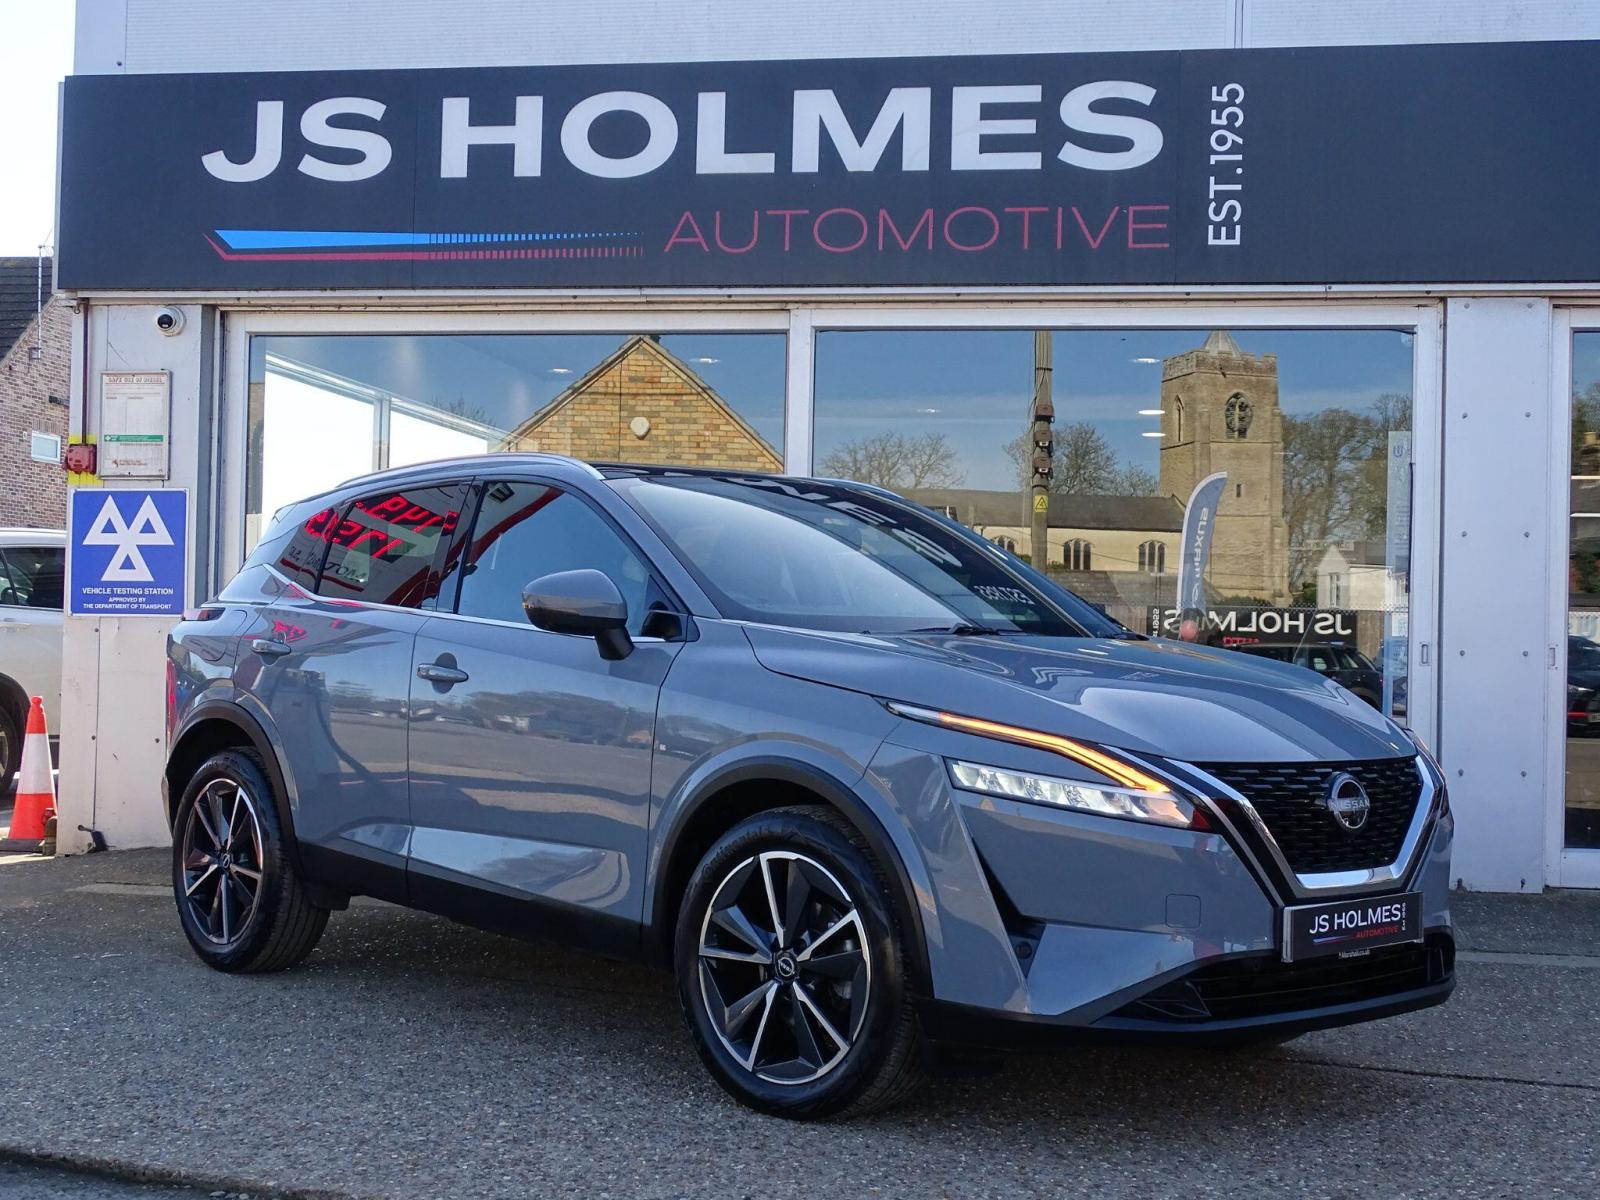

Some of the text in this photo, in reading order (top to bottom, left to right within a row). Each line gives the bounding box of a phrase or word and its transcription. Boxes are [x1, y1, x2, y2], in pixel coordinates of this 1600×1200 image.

[201, 80, 1164, 183] JS HOLMES
[1208, 82, 1246, 246] EST.1955
[664, 205, 1170, 253] AUTOMOTIVE
[82, 587, 174, 595] VEHICLE TESTING STATION
[1328, 799, 1370, 811] NISSAN
[1309, 904, 1402, 934] JS HOLMES
[1356, 925, 1399, 938] AUTOMOTIVE
